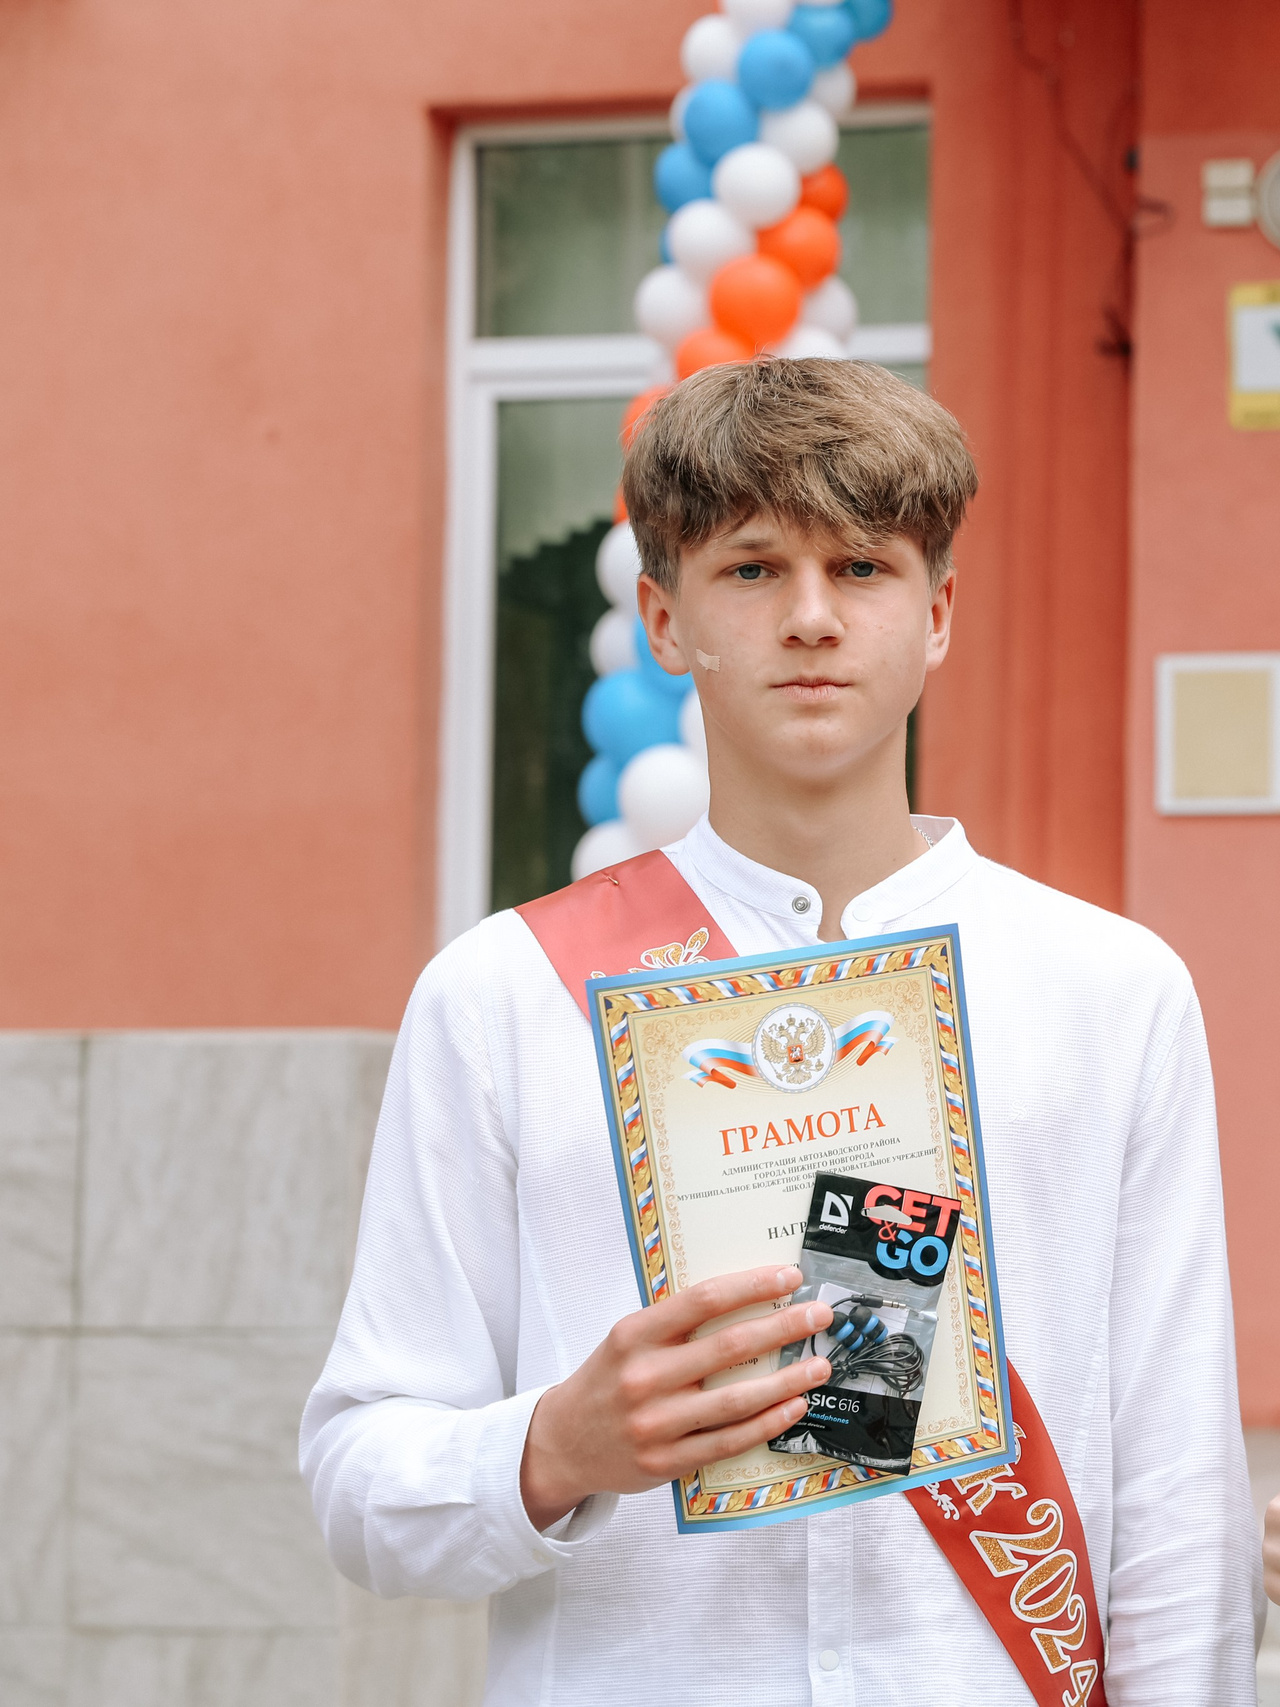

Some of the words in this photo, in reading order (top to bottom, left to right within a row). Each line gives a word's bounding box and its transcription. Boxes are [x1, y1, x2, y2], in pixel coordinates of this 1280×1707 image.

[719, 1103, 886, 1156] ГРАМОТА
[677, 1184, 750, 1202] МУНИЦИПАЛЬНОЕ
[752, 1175, 801, 1190] БЮДЖЕТНОЕ
[892, 1147, 938, 1161] УЧРЕЖДЕНИЕ
[722, 1157, 796, 1176] АДМИНИСТРАЦИЯ
[799, 1143, 869, 1161] АВТОЗАВОДСКОГО
[870, 1137, 901, 1148] РАЙОНА
[754, 1169, 787, 1180] ГОРОДА
[788, 1160, 828, 1174] НИЖНЕГО
[830, 1151, 875, 1166] НОВГОРОДА
[819, 1223, 847, 1234] defender
[864, 1184, 961, 1238] GET
[876, 1229, 949, 1277] GO
[802, 1392, 837, 1409] ASIC
[838, 1398, 860, 1413] 616
[808, 1411, 849, 1424] headphones
